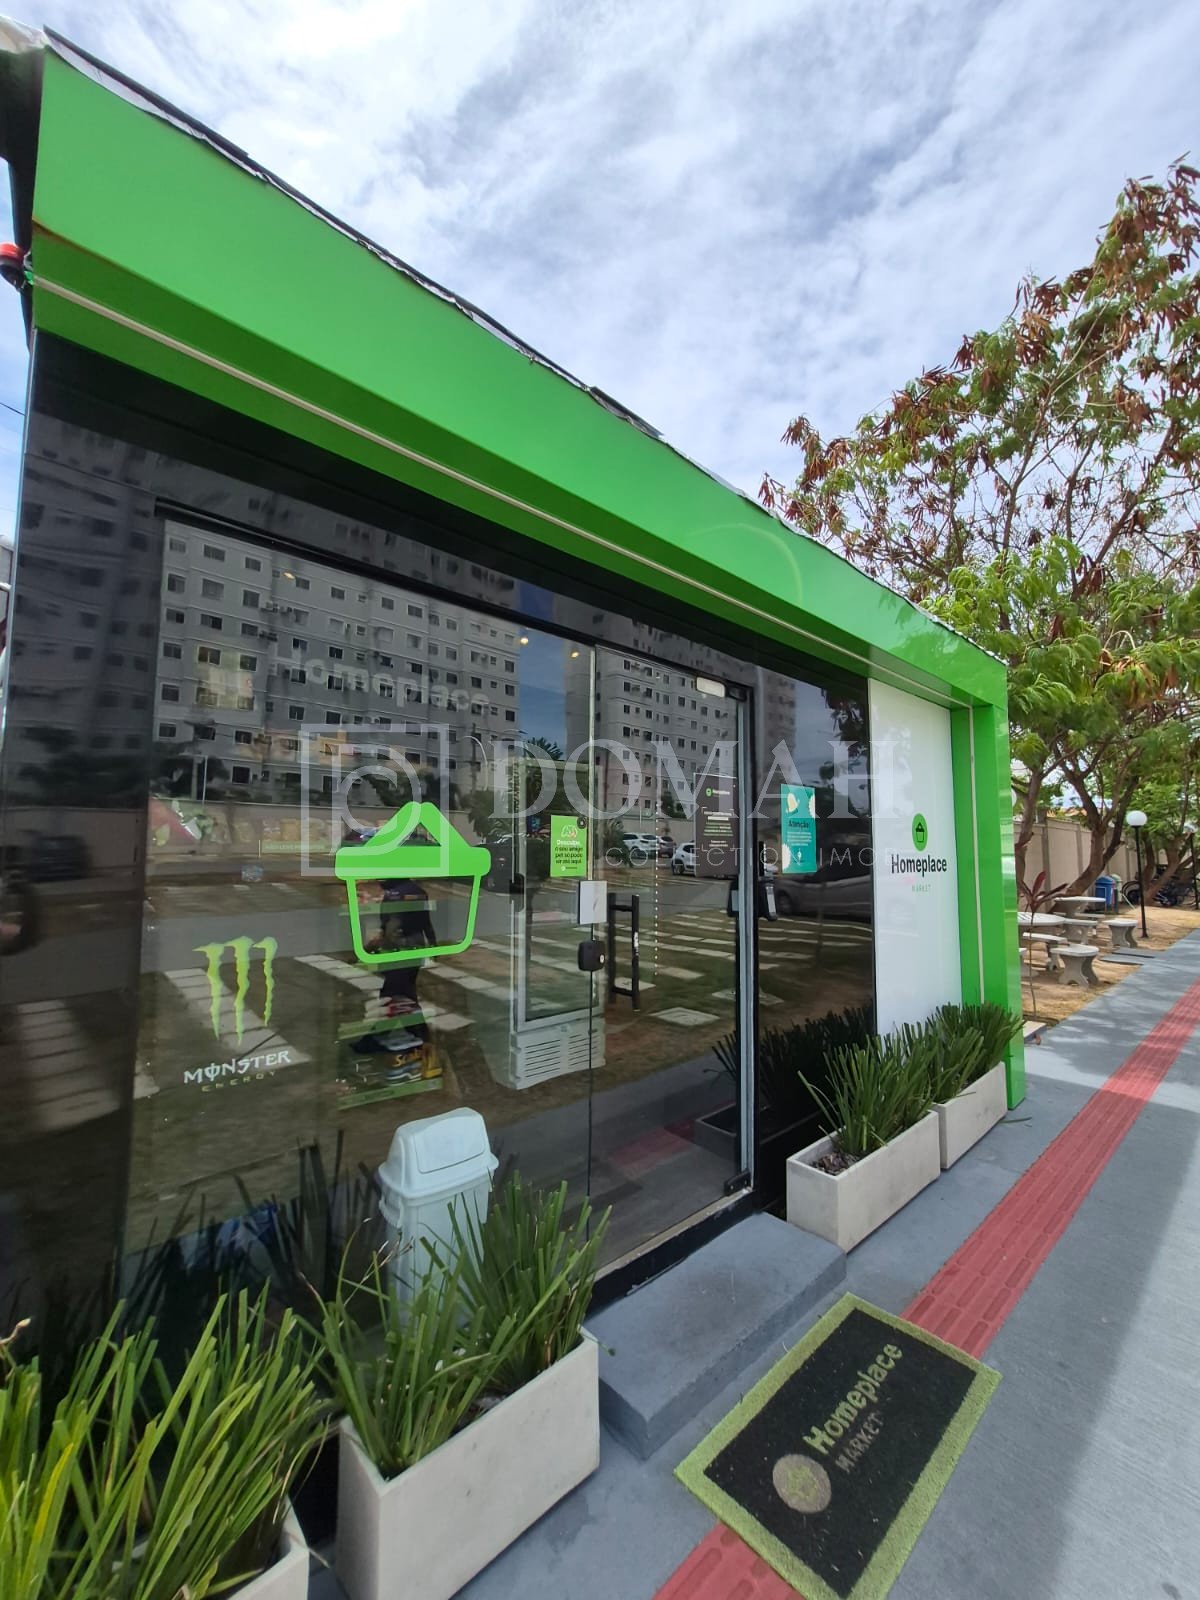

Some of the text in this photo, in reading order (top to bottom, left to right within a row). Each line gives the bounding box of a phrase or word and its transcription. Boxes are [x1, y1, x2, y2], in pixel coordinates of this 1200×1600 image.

[891, 853, 947, 877] Homeplace
[802, 1344, 902, 1454] Homeplace
[835, 1411, 884, 1473] MARKET
